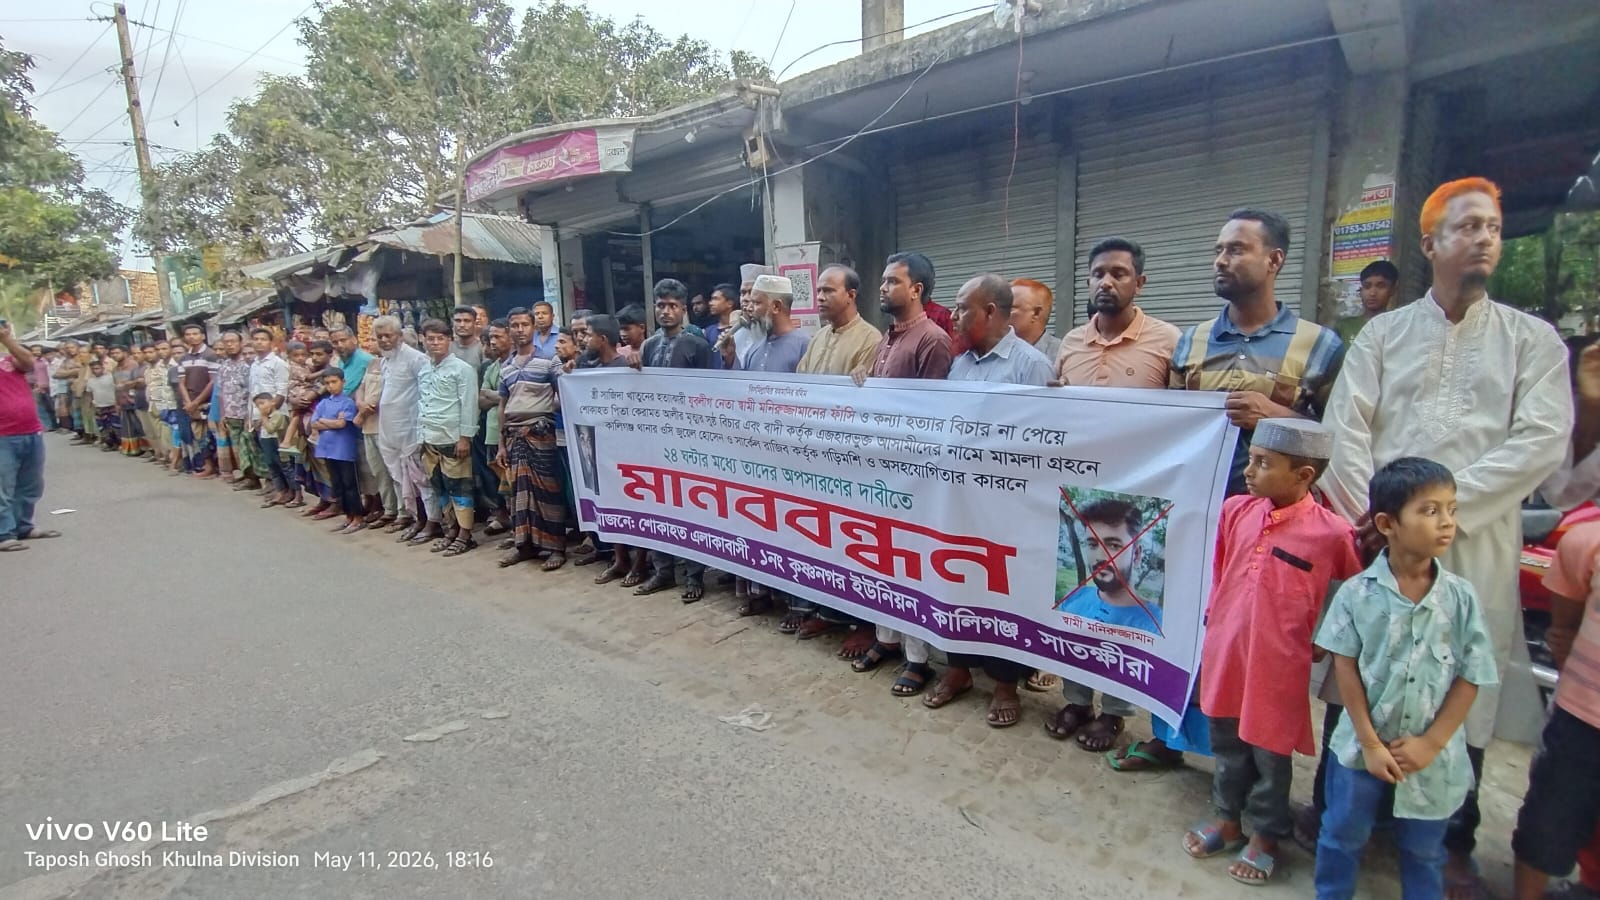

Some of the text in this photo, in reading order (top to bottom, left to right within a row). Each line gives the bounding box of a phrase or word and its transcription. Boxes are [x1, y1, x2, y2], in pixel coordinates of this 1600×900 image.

[611, 404, 629, 416] পিতা
[719, 415, 741, 430] বিচার
[743, 421, 760, 434] এবং
[764, 419, 783, 436] বাদী
[786, 422, 813, 443] কর্তৃক
[816, 430, 873, 450] এজহারভুক্ত
[876, 434, 942, 457] আসামীদের
[947, 444, 984, 462] নামে
[989, 450, 1042, 470] মামলা
[1047, 456, 1101, 478] গ্রহনে
[688, 393, 712, 409] যুবলীগ
[715, 398, 734, 410] নেতা
[738, 398, 755, 413] স্বামী
[759, 400, 827, 420] মনিরুজ্জামানের
[830, 405, 857, 423] ফাঁসি
[860, 412, 869, 423] ও
[873, 412, 902, 429] কন্যা
[906, 415, 946, 432] হত্যার
[950, 414, 992, 438] বিচার
[997, 424, 1017, 440] না
[1022, 426, 1068, 446] পেয়ে
[637, 423, 658, 433] থানার
[698, 429, 724, 443] হোসেন
[764, 440, 790, 455] রাজিব
[791, 444, 818, 463] কর্তৃক
[865, 458, 876, 468] ও
[879, 456, 966, 485] অসহযোগিতার
[972, 471, 1029, 493] কারনে
[663, 447, 678, 464] ২৪
[711, 455, 737, 474] মধ্যে
[741, 460, 777, 481] তাদের
[781, 468, 853, 497] অপসারণের
[858, 479, 914, 510] দাবীতে
[617, 463, 1017, 596] মানববন্ধন
[639, 517, 688, 540] শোকাহত
[760, 549, 785, 572] ১নং
[788, 557, 846, 591] কৃষ্ণনগর
[1037, 629, 1154, 686] সাতক্ষীরা
[1061, 616, 1155, 646] স্বামী মনিরুজ্জামান
